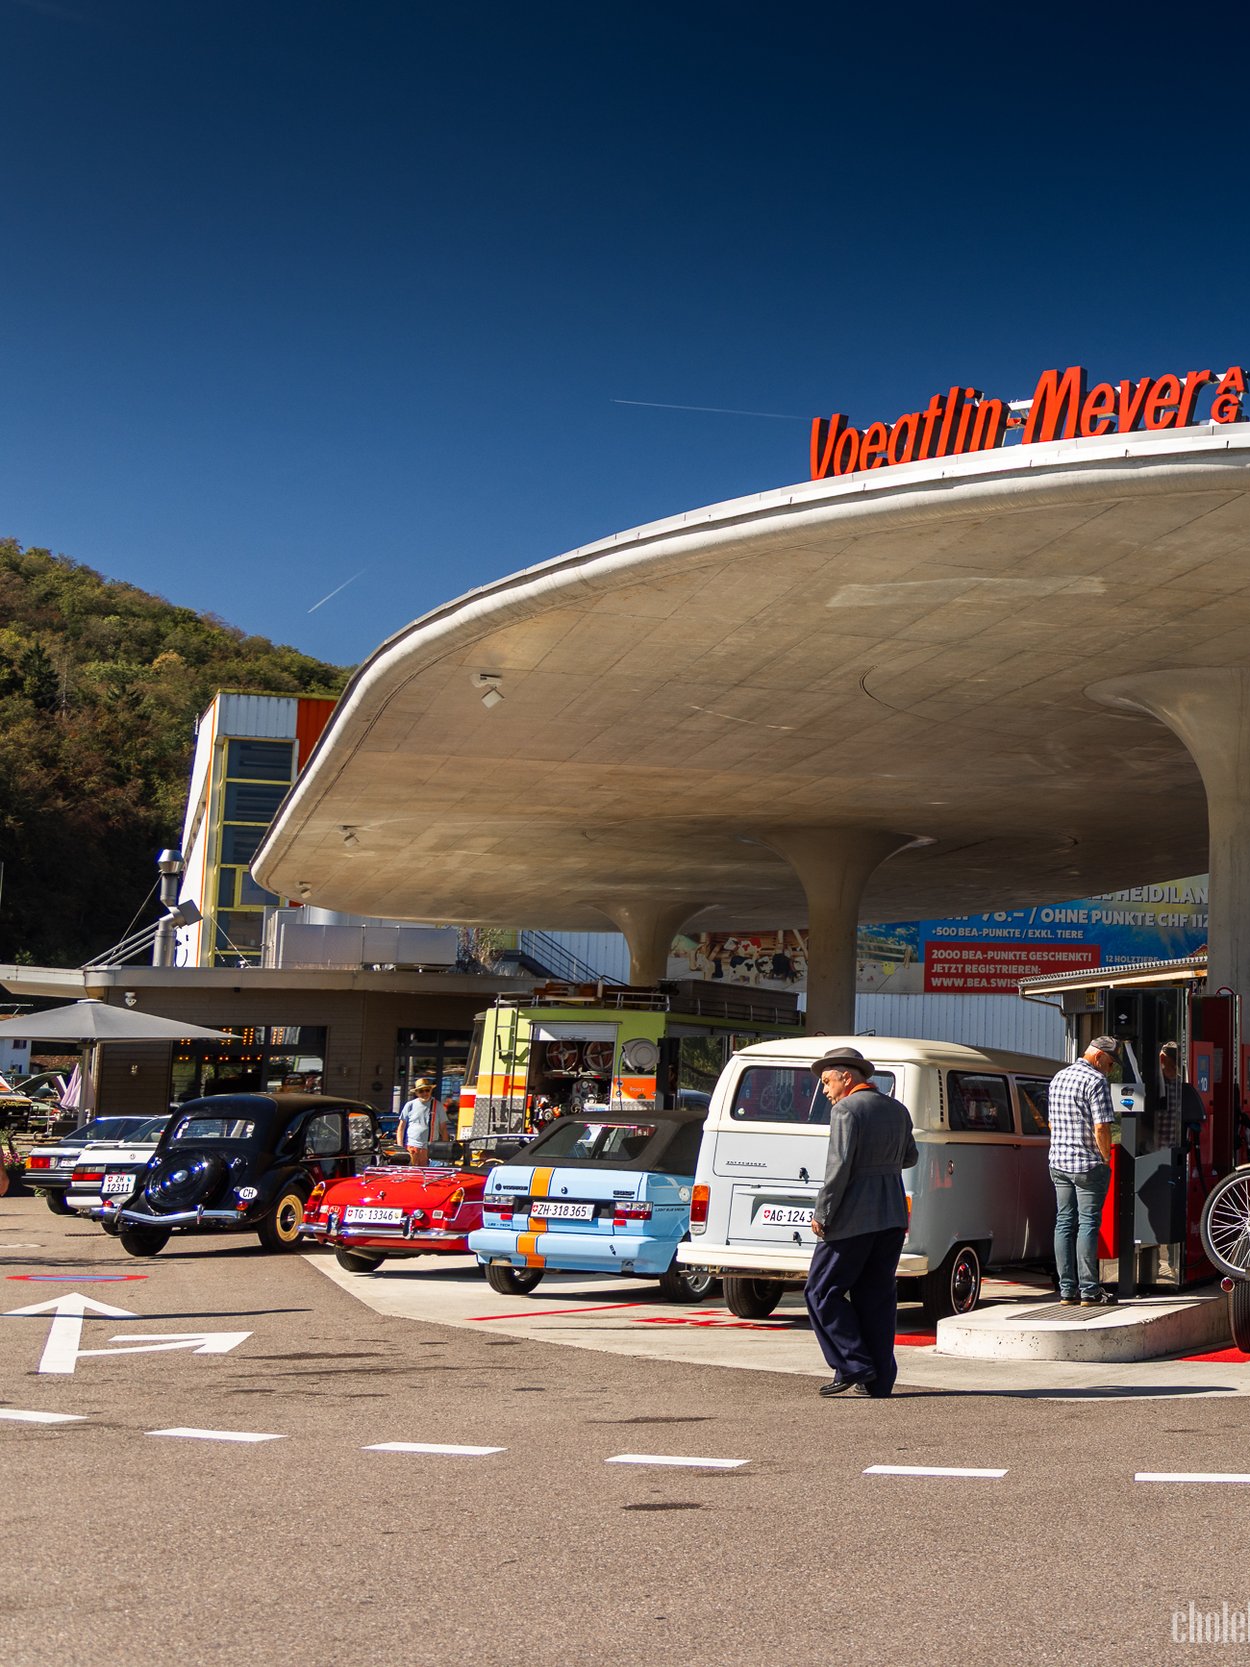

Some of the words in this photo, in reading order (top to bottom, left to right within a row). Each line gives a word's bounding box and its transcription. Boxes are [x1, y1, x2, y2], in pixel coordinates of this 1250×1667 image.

[1040, 907, 1088, 925] OHNE
[1091, 909, 1155, 927] PUNKTE
[1157, 911, 1189, 928] CHF
[958, 928, 1021, 939] BEA-PUNKTE
[1028, 929, 1055, 939] EXKL.
[1057, 930, 1084, 939] TIERE
[931, 949, 961, 960] 2000
[962, 950, 1027, 961] BEA-PUNKTE
[1029, 951, 1092, 962] GESCHENKT!
[931, 963, 964, 973] JETZT
[965, 964, 1041, 975] REGISTRIEREN:
[106, 1183, 130, 1193] 12311
[242, 1187, 254, 1199] CH
